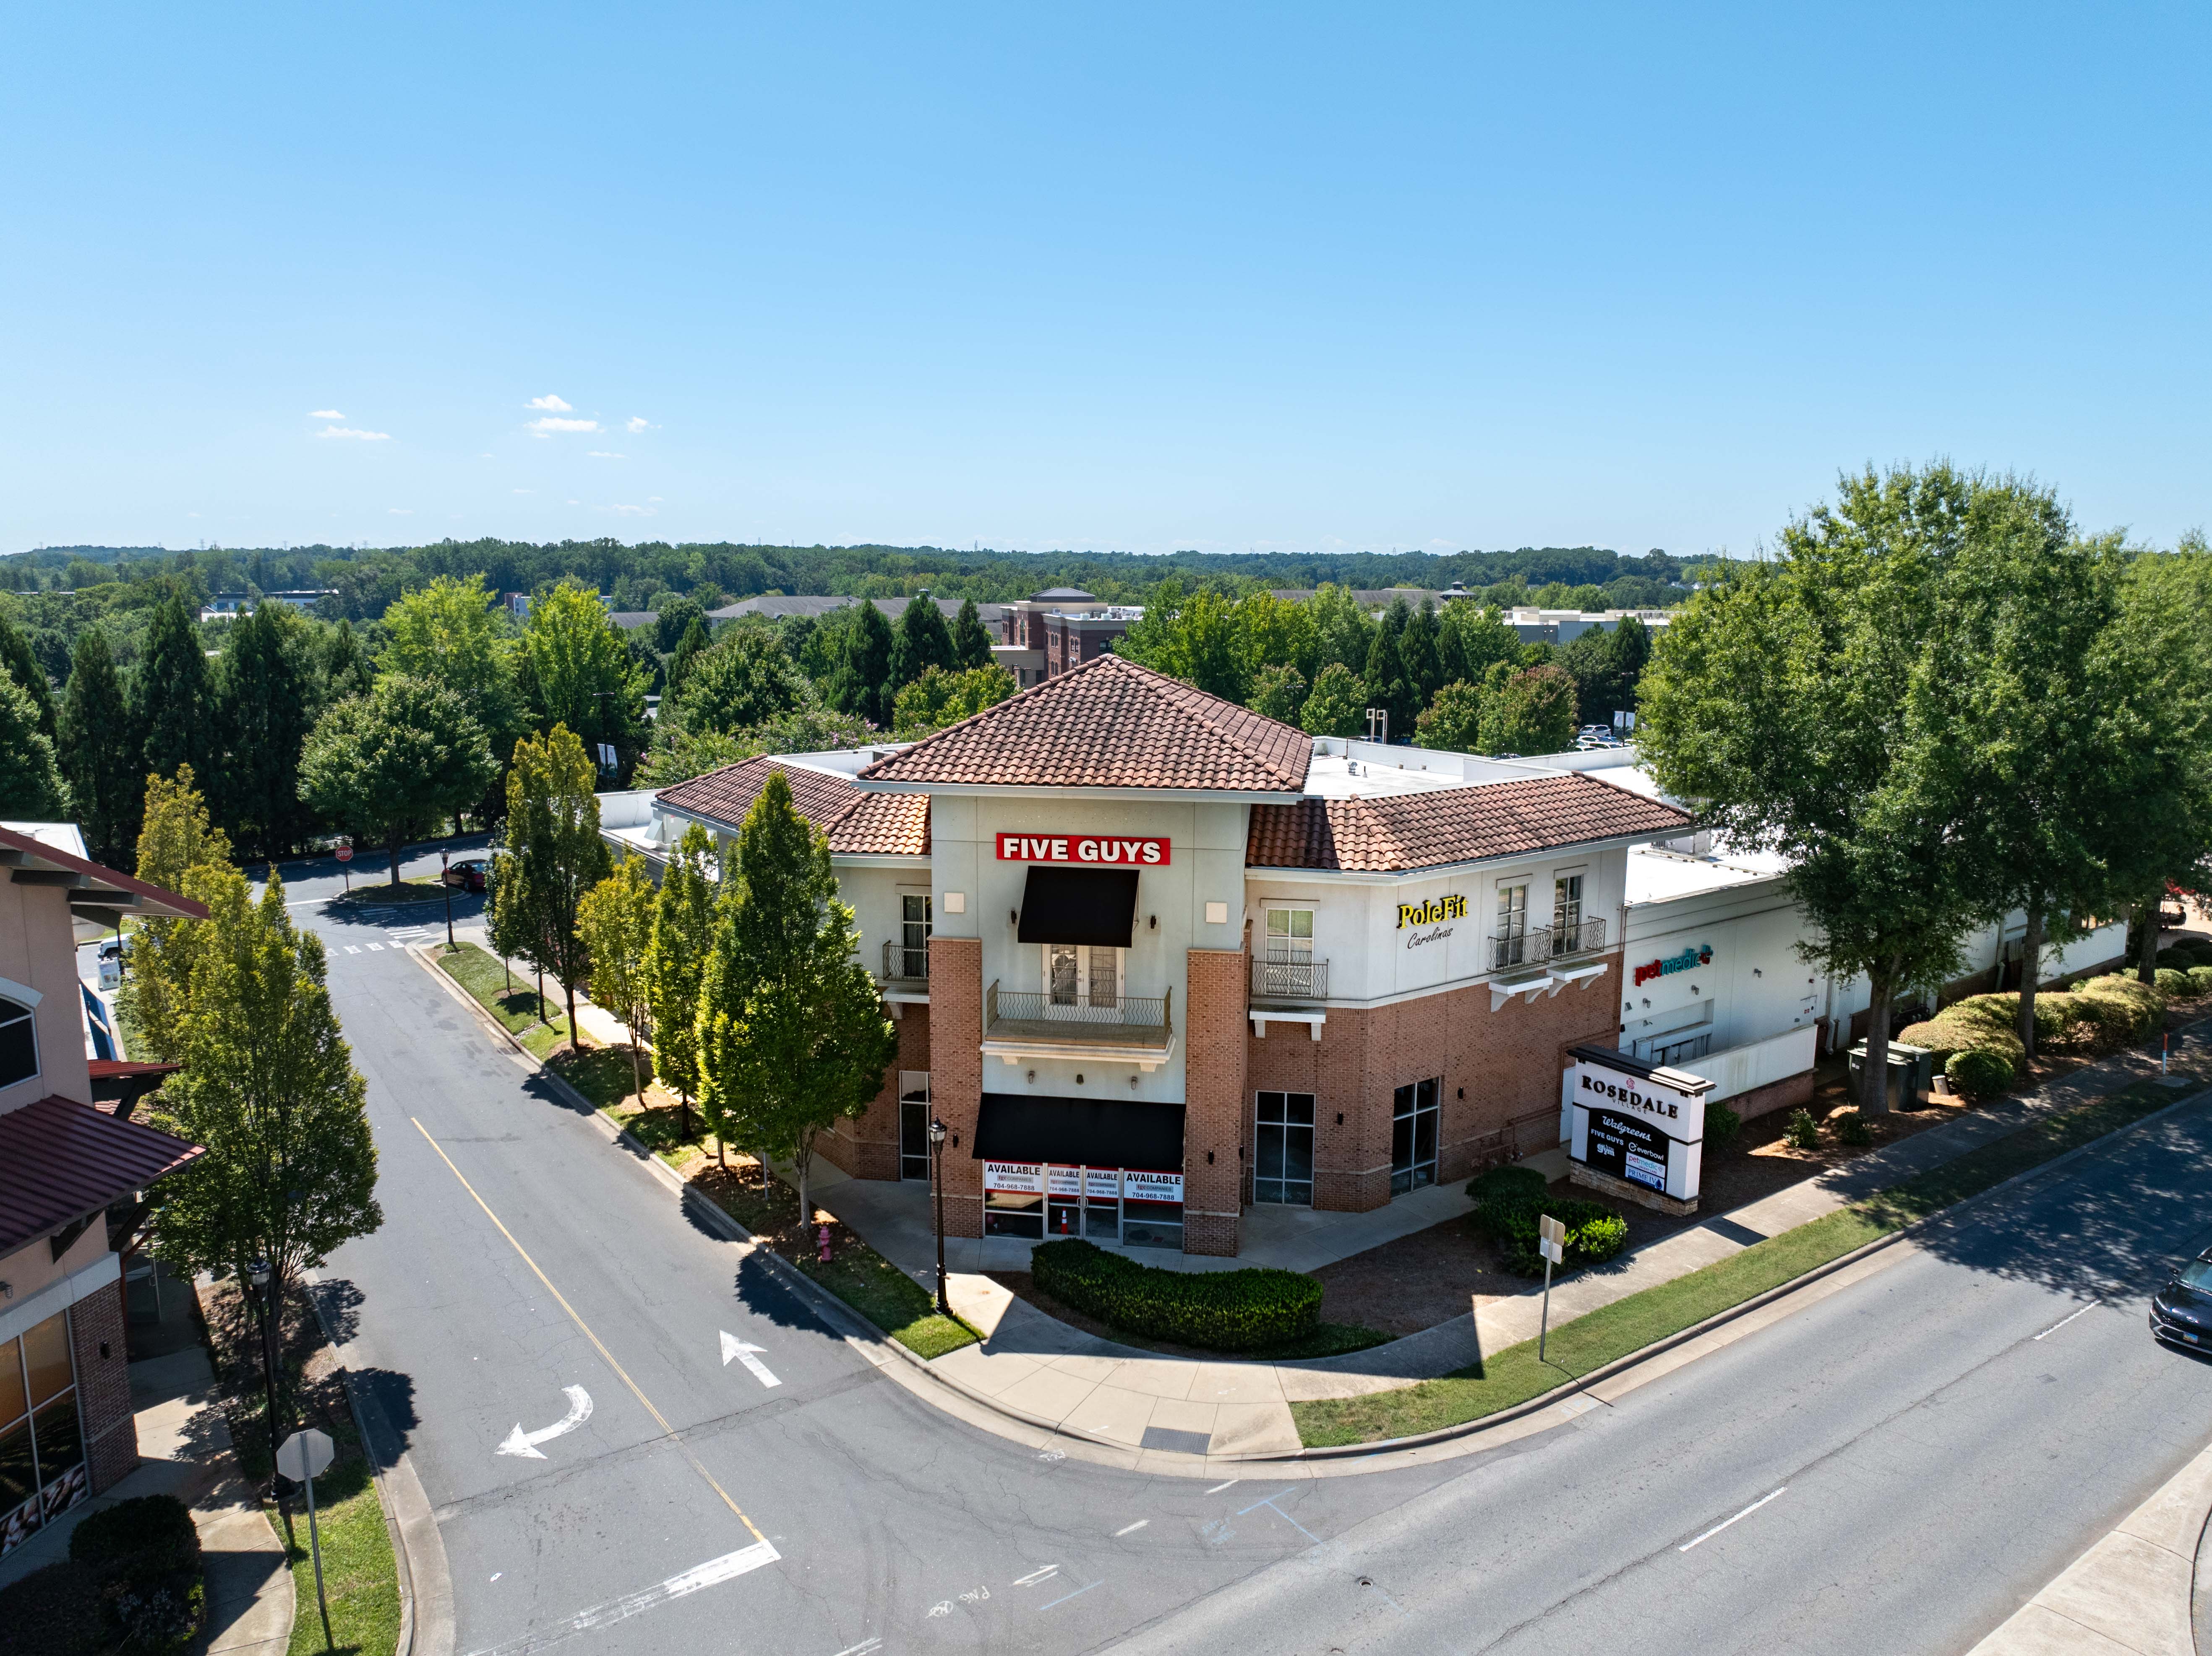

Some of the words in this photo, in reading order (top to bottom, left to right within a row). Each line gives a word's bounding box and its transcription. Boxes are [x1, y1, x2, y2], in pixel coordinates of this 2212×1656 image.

[1003, 838, 1069, 860] FIVE
[1078, 840, 1161, 864] GUYS
[1396, 894, 1469, 929] PoleFit
[1407, 926, 1453, 949] Carolinas
[1635, 948, 1701, 987] petmedic
[1581, 1075, 1678, 1120] ROSEDALE
[1612, 1098, 1647, 1114] VILLAGE
[1591, 1128, 1605, 1139] FIVE
[1606, 1134, 1624, 1146] GUYS
[1602, 1115, 1652, 1142] Walgreens
[1637, 1147, 1664, 1161] everbowl
[988, 1164, 1041, 1175] AVAILABLE
[1628, 1155, 1658, 1171] petmedic
[1127, 1173, 1181, 1185] AVAILABLE
[1628, 1168, 1648, 1181] PRIME
[1649, 1176, 1656, 1184] IV
[1132, 1192, 1175, 1200] 704-968-7888
